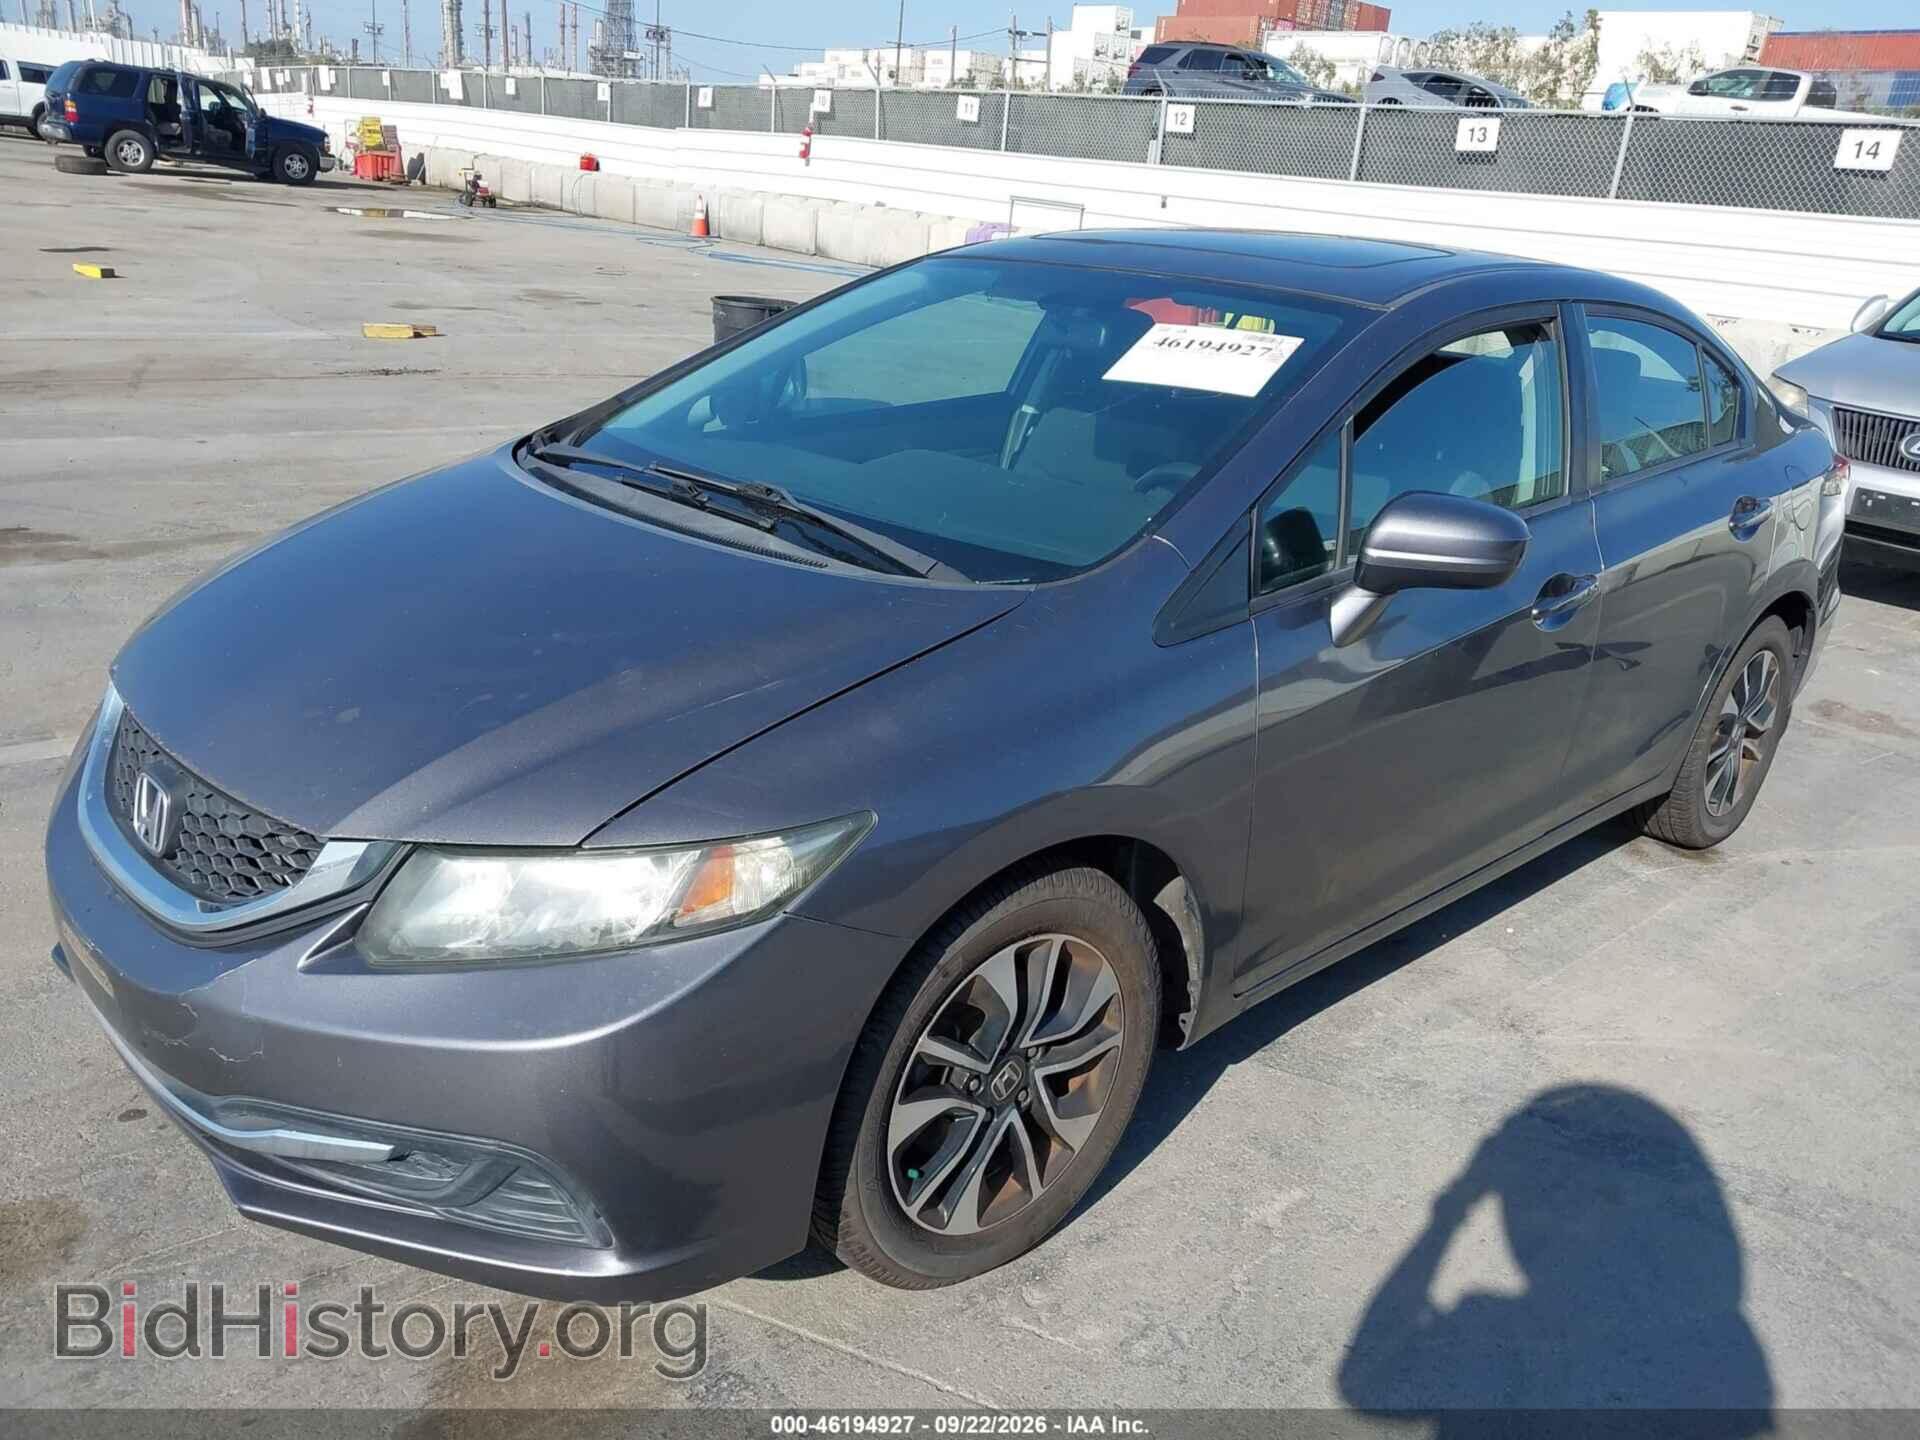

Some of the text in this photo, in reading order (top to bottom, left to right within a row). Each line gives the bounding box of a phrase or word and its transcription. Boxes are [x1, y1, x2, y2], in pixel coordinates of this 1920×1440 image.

[964, 102, 974, 115] 11
[1174, 111, 1187, 126] 12
[1468, 126, 1488, 143] 13
[1854, 140, 1881, 160] 14
[1154, 337, 1273, 357] 46194927
